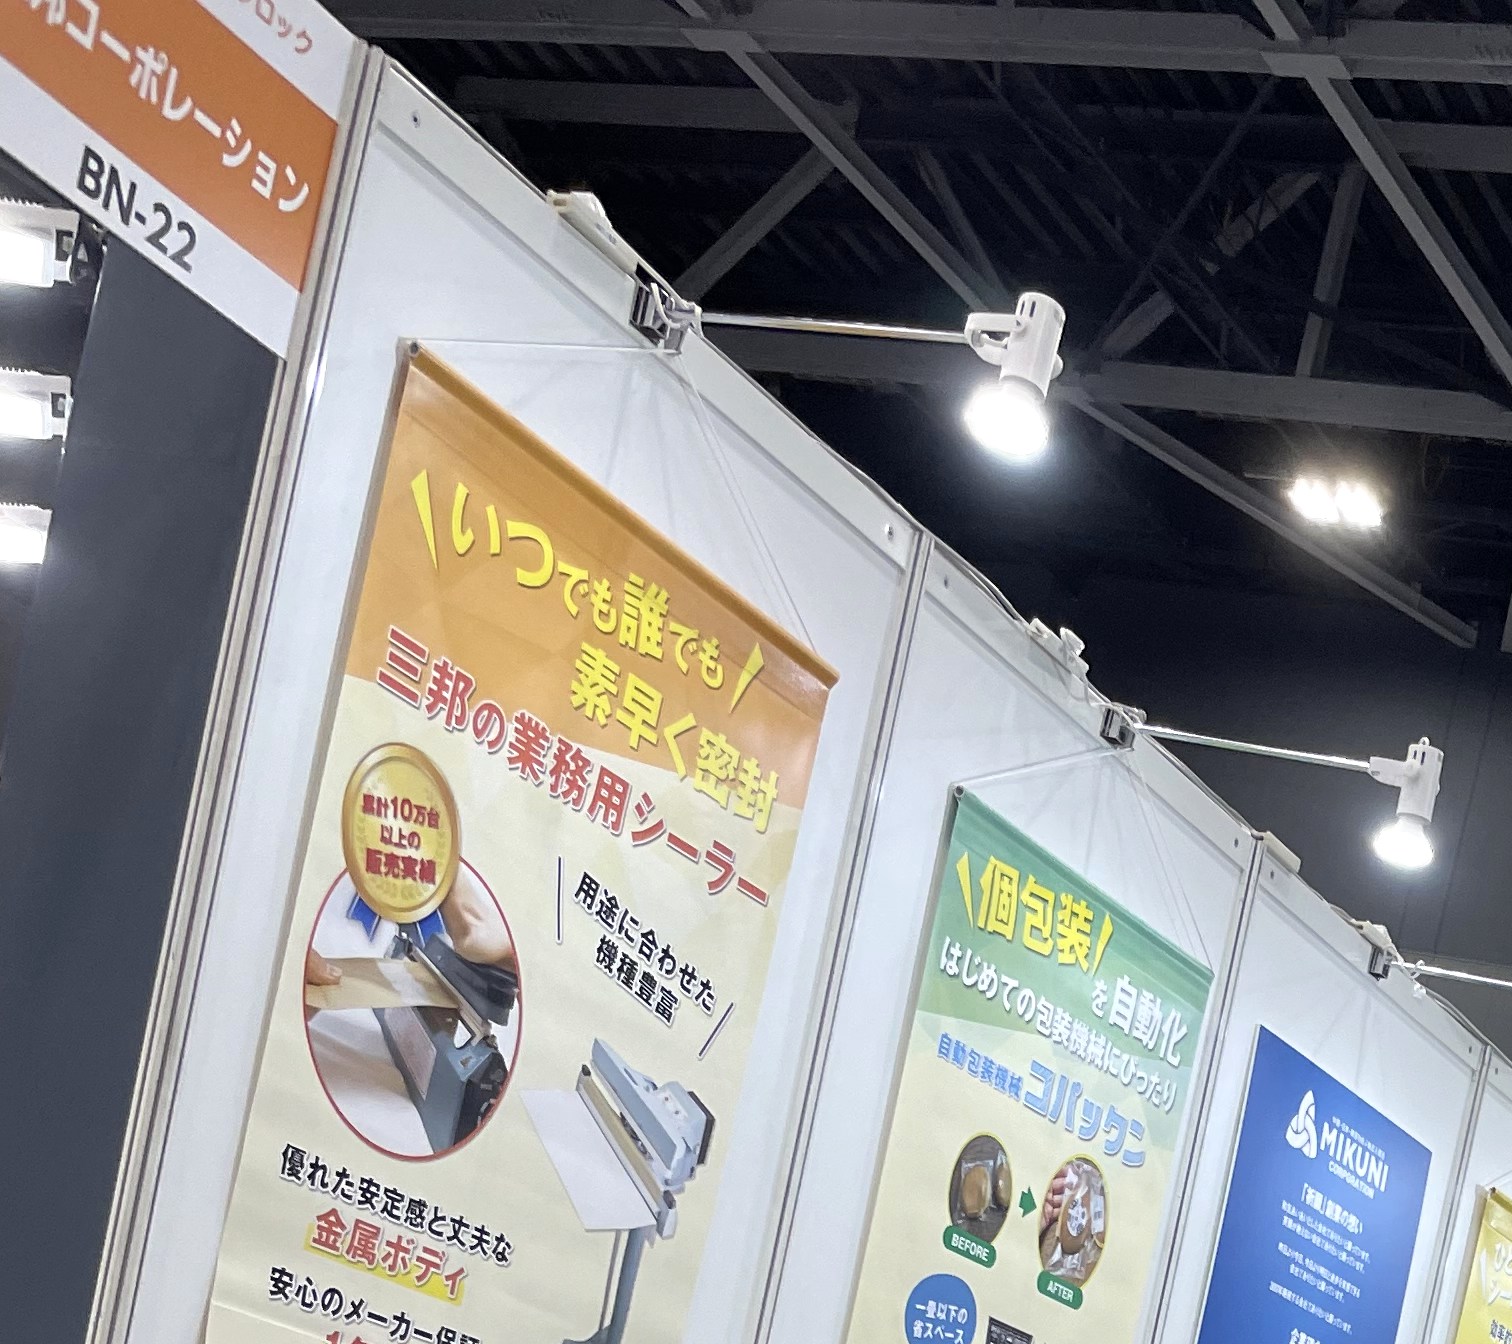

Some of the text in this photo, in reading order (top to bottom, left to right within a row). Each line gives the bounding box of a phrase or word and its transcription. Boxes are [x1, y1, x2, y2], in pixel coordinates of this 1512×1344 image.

[240, 0, 313, 54] ロック
[77, 144, 198, 274] BN-22
[451, 481, 725, 690] いつでも誰でも
[376, 627, 771, 907] 三邦の業務用シーラー
[569, 642, 780, 835] 素早く密封
[361, 792, 441, 829] 累計10万台
[379, 823, 421, 852] 以上の
[364, 852, 437, 887] 販売実績
[573, 871, 718, 1014] 用途に合わせた
[594, 937, 680, 1025] 機種豊富
[977, 854, 1189, 1068] 個包装 を自動化
[1320, 1121, 1389, 1193] MIKUNI
[280, 1143, 515, 1265] 優れた安定感と丈夫な
[950, 1233, 990, 1263] BEFORE
[309, 1206, 468, 1300] 金属ボディ
[1046, 1279, 1075, 1303] AFTER
